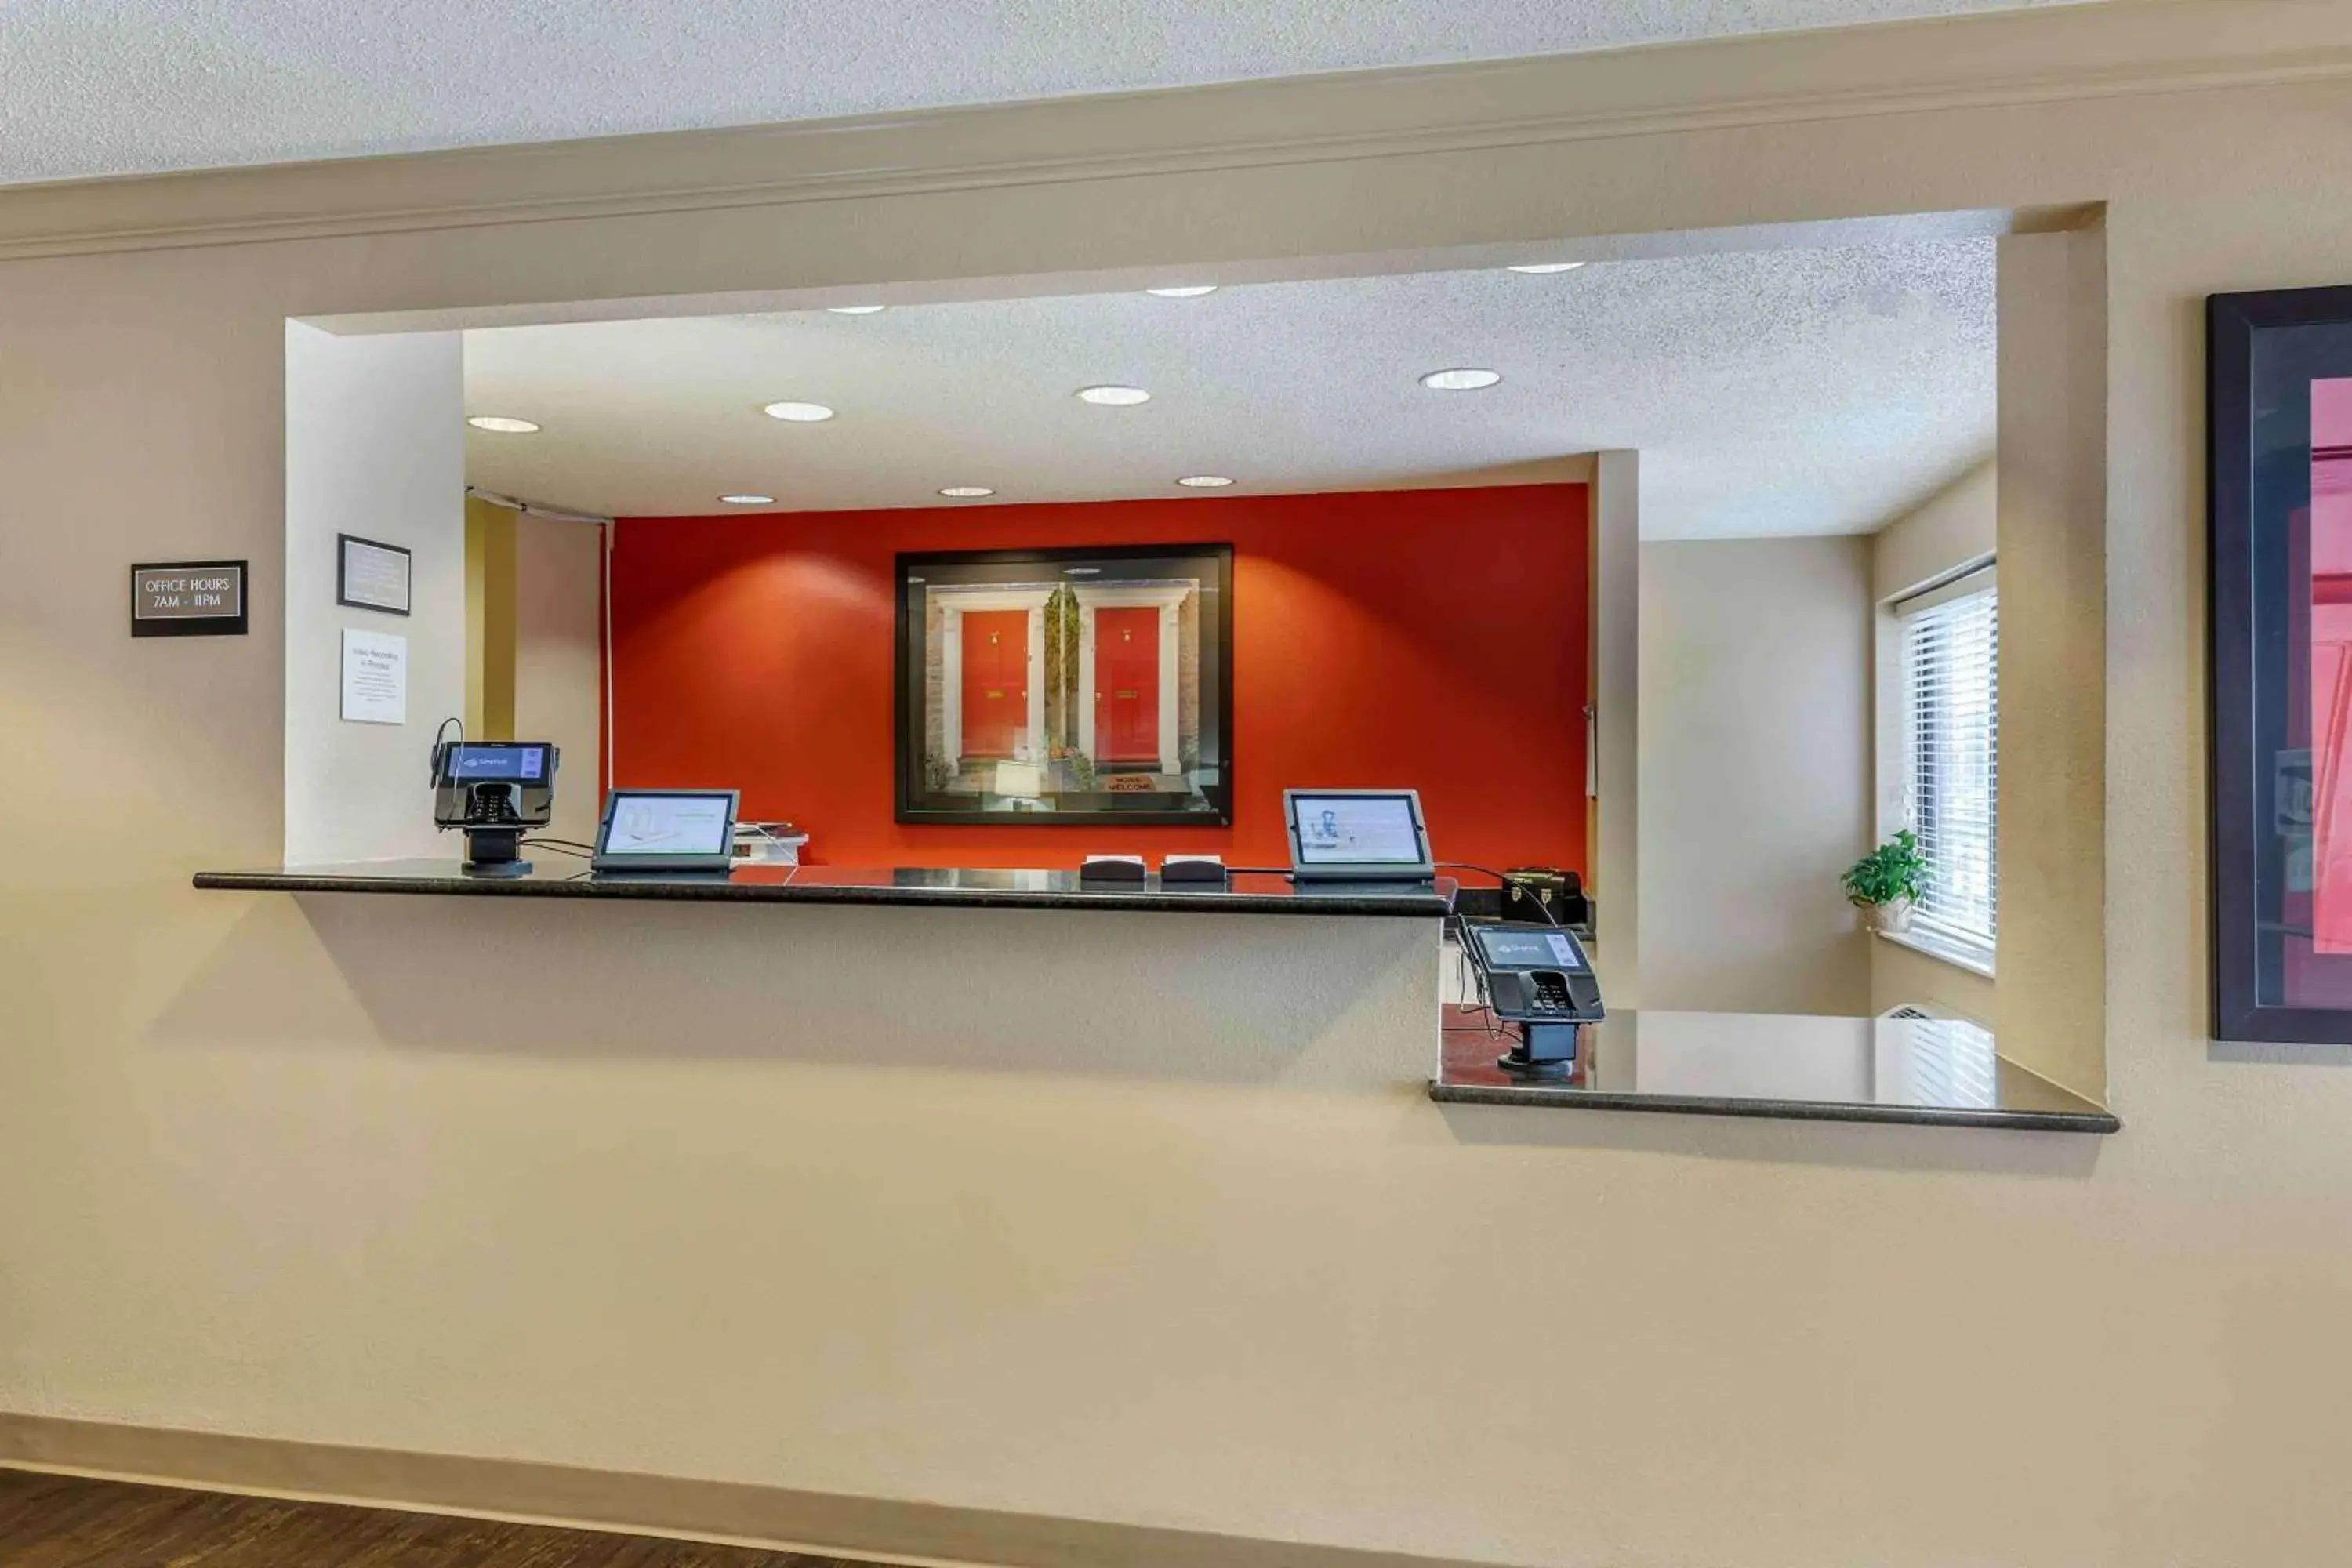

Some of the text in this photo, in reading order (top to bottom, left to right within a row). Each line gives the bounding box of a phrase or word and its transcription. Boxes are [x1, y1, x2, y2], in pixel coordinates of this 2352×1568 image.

[145, 578, 230, 592] OFFICE HOURS
[154, 595, 180, 608] 7AM
